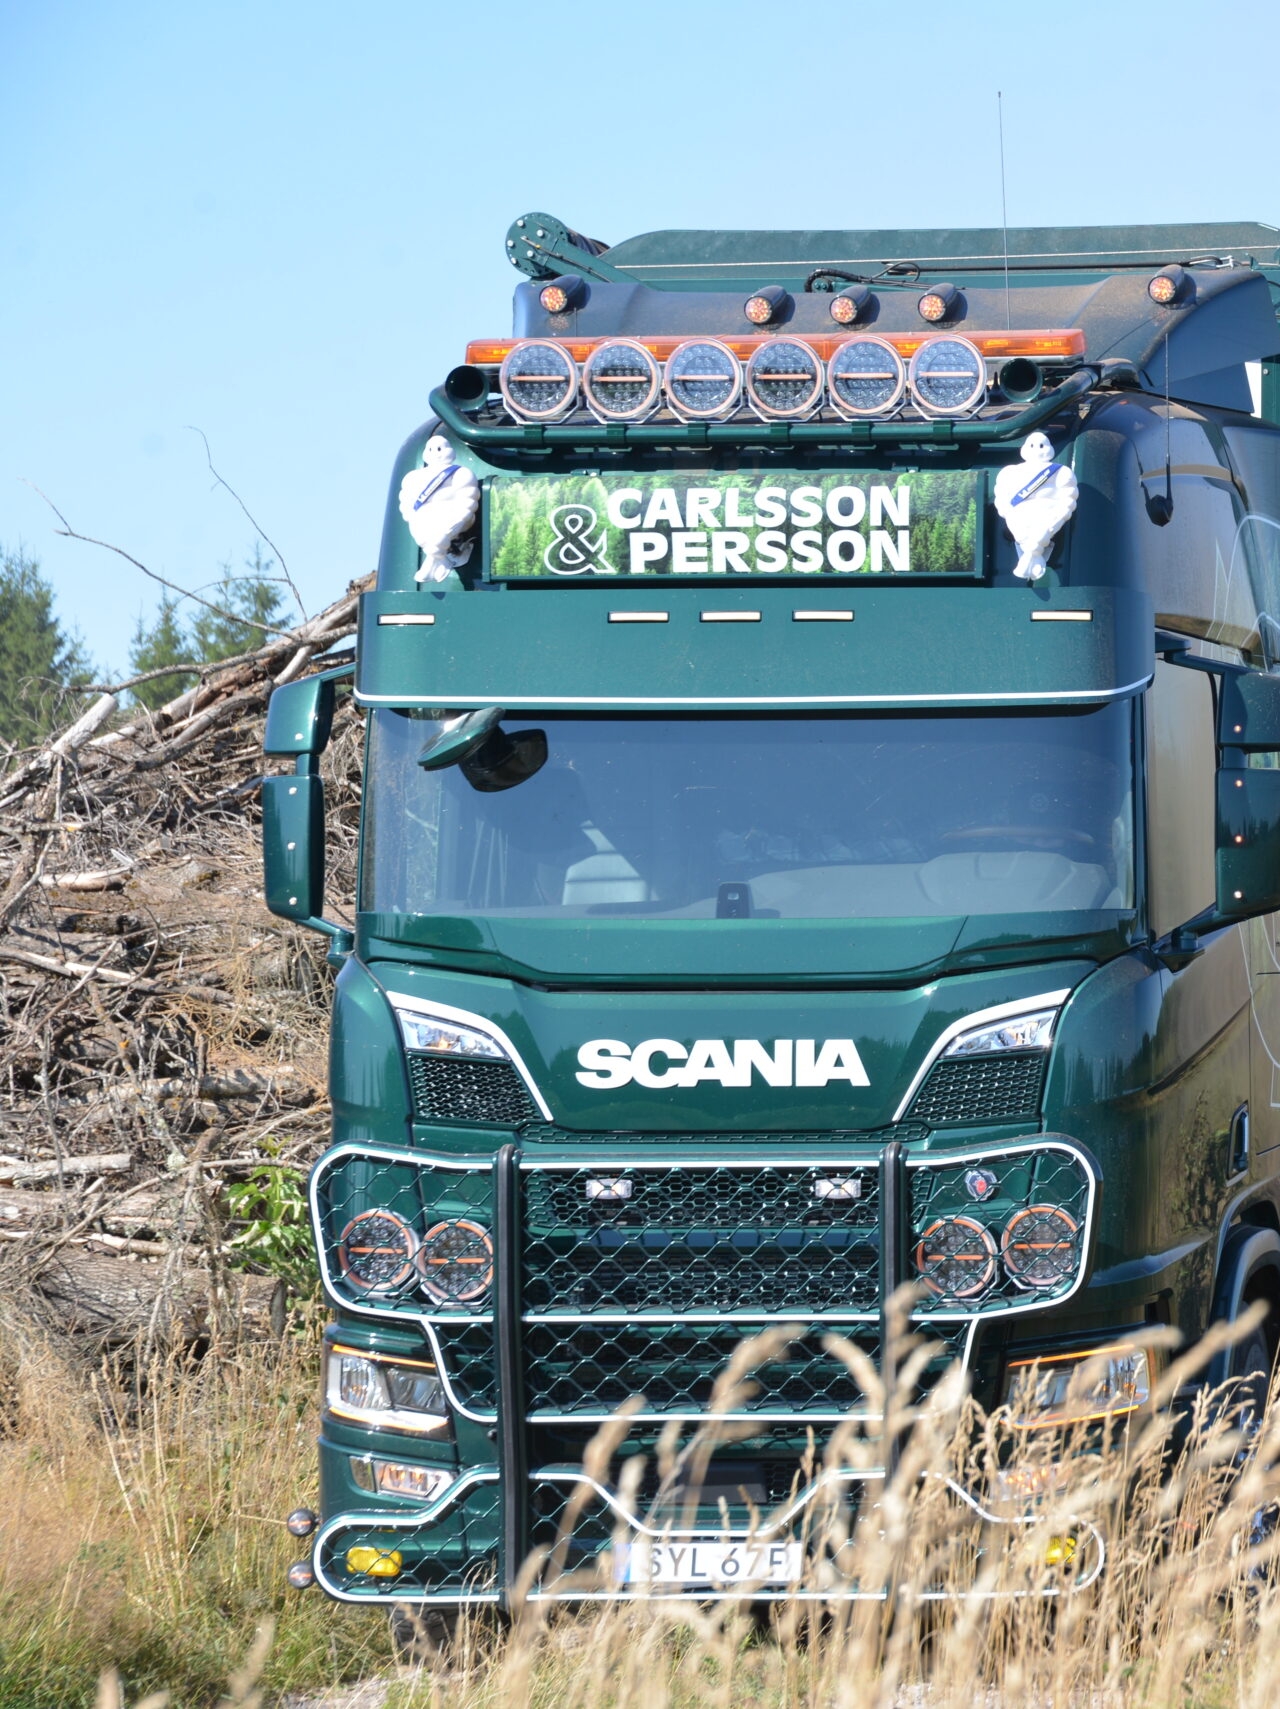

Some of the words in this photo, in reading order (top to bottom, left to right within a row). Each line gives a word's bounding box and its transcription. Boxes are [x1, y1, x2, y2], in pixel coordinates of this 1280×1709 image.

[607, 485, 911, 530] CARLSSON
[543, 503, 616, 576] &
[629, 530, 911, 574] PERSSON
[575, 1038, 871, 1089] SCANIA
